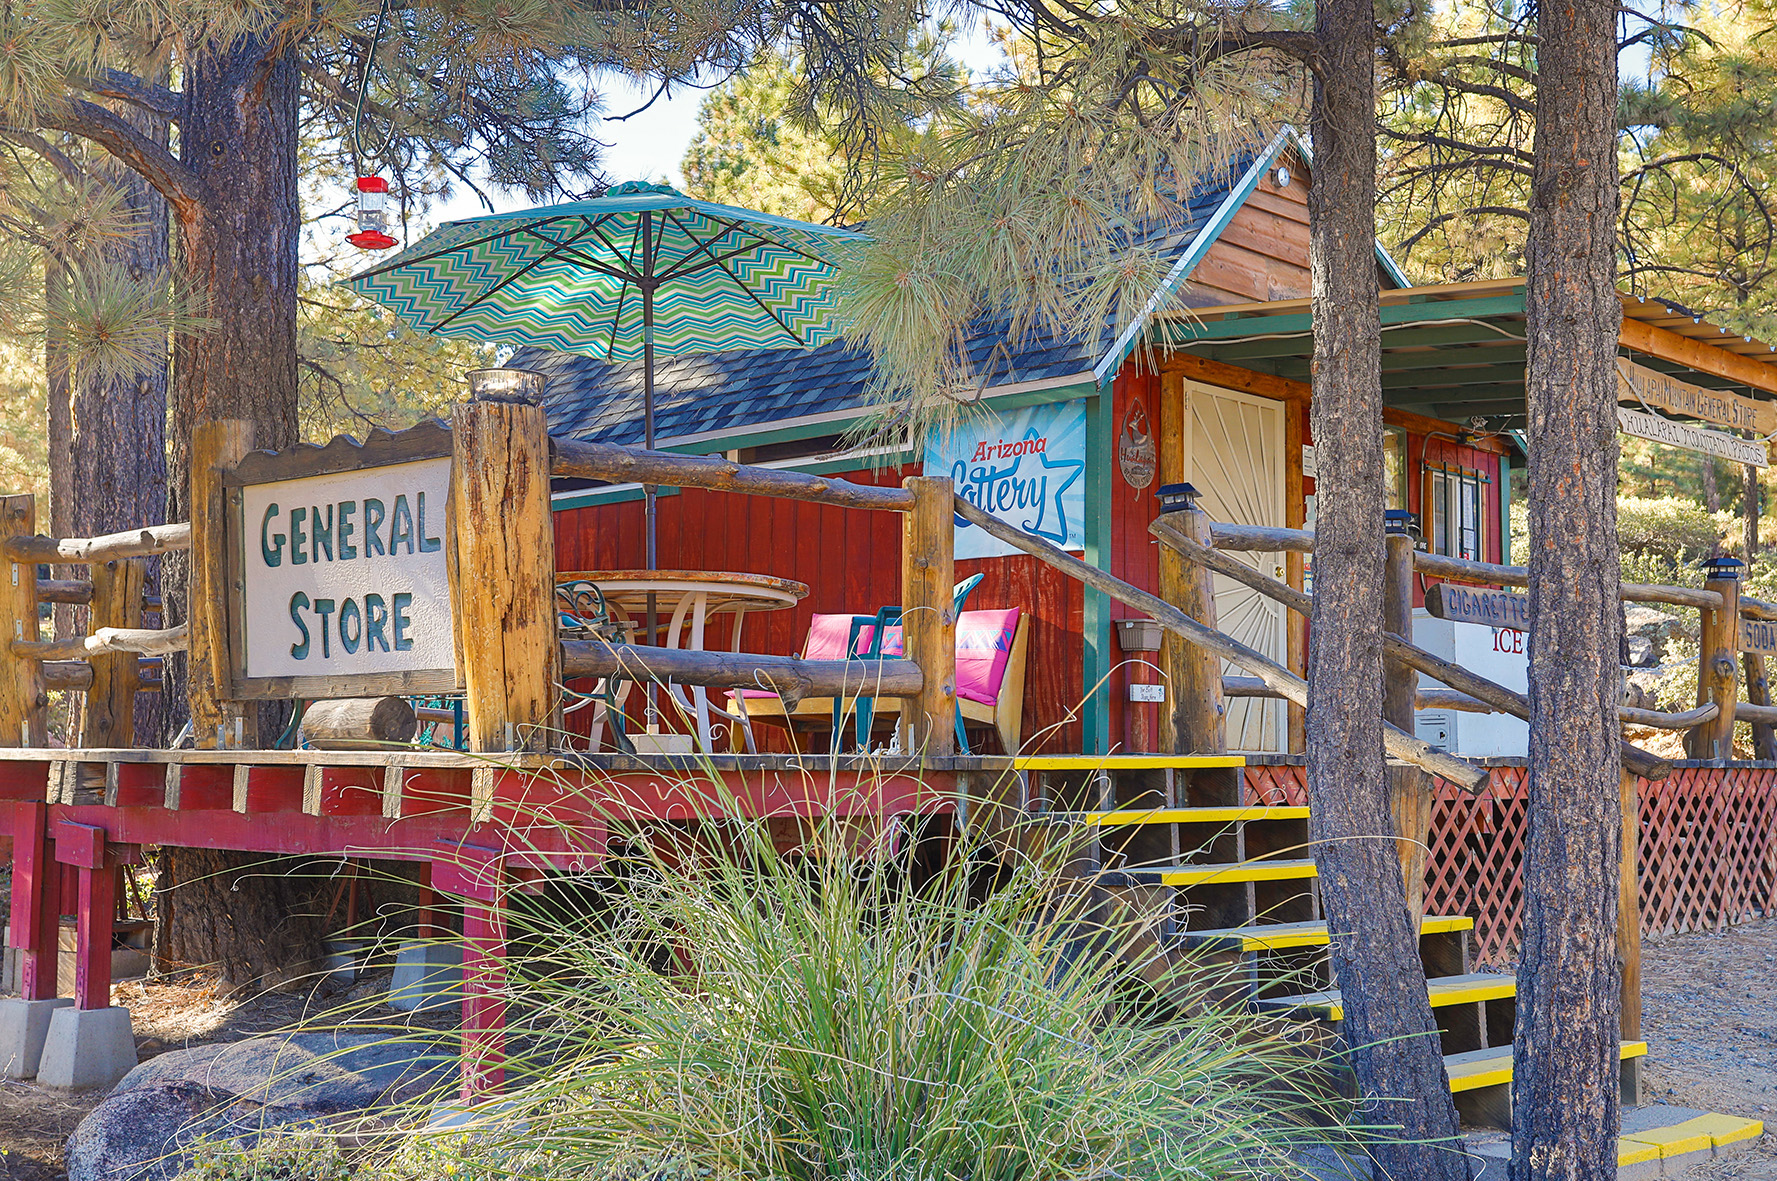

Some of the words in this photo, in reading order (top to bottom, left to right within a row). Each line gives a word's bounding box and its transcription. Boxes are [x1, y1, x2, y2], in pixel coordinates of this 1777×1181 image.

[1697, 389, 1731, 423] GENERAL
[1732, 399, 1758, 429] STORE
[1624, 413, 1680, 443] HUALAPAI
[970, 437, 1047, 463] Arizona
[261, 491, 442, 568] GENERAL
[289, 590, 415, 661] STORE
[1746, 622, 1777, 652] SODA
[1493, 628, 1524, 655] ICE
